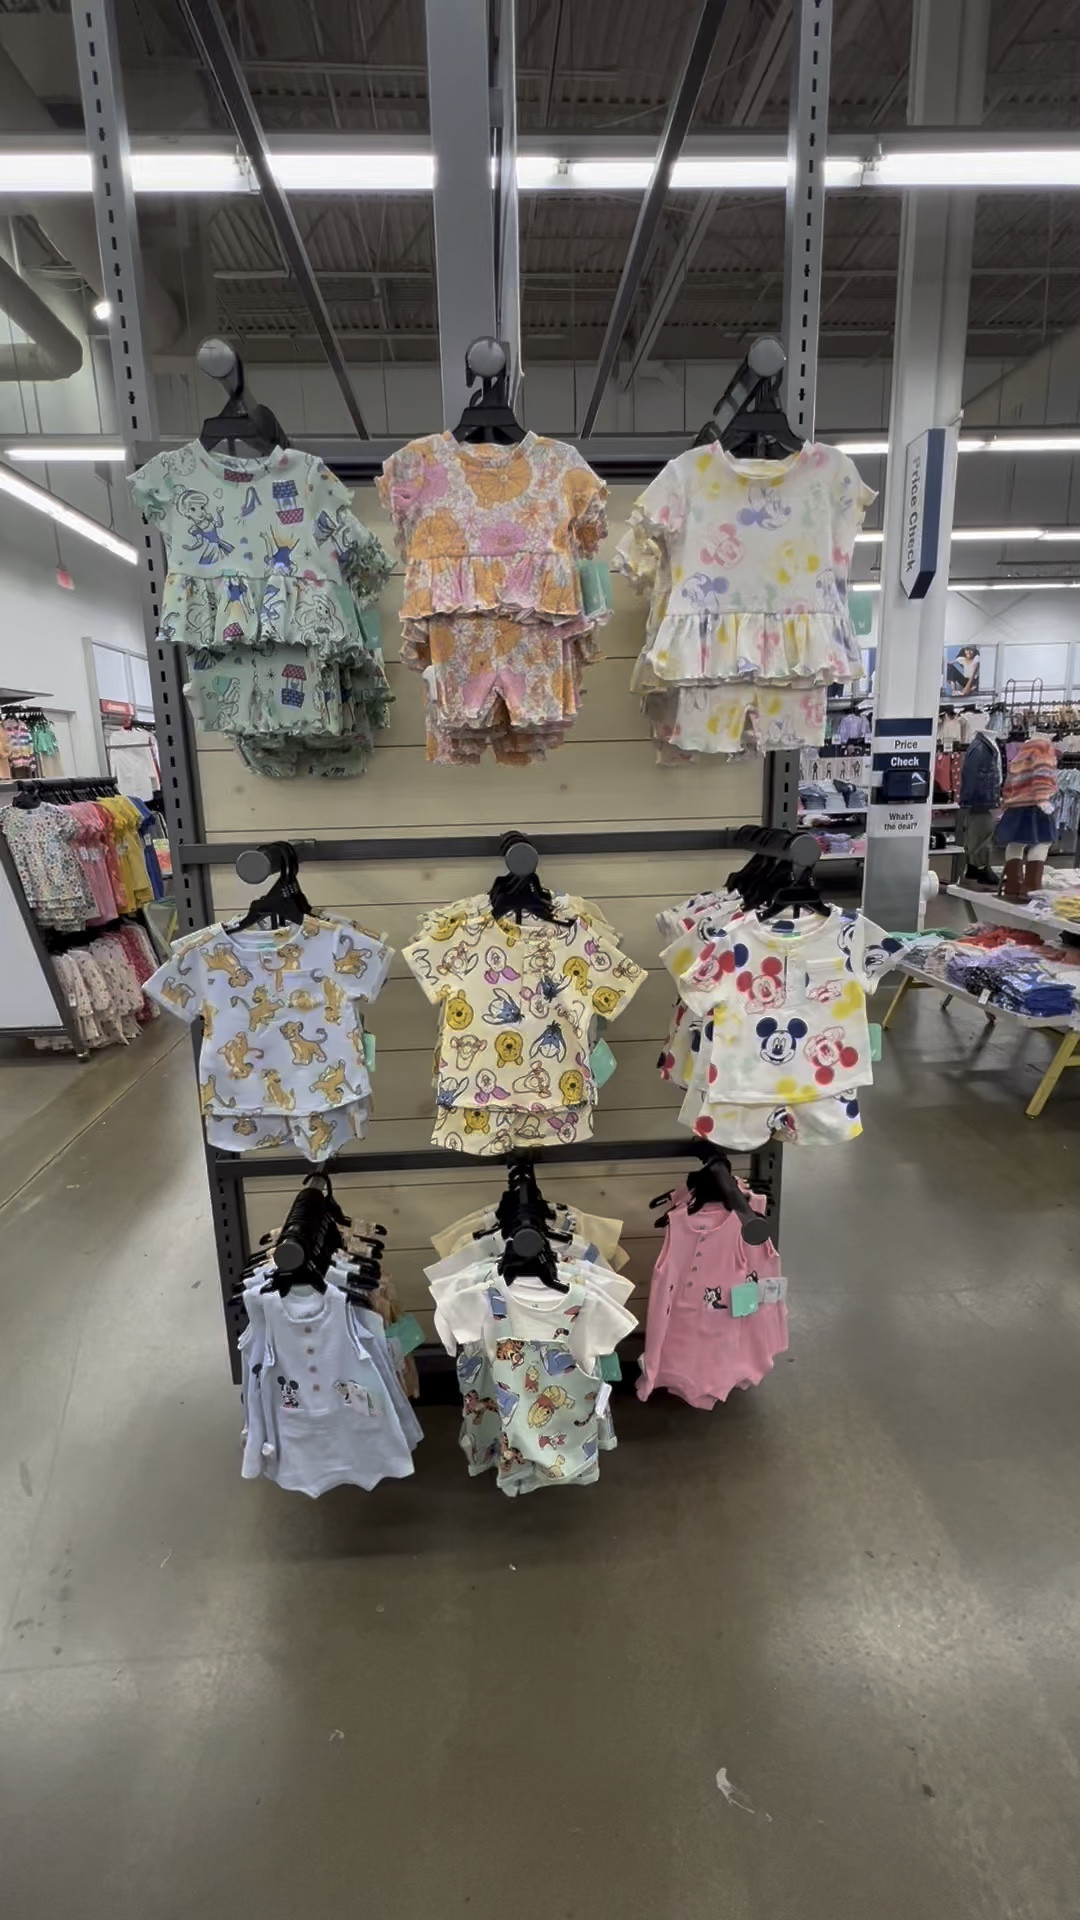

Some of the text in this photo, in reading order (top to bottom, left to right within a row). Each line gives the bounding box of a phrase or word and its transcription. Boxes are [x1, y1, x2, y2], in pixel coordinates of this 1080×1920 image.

[906, 456, 921, 573] Price Check
[894, 740, 918, 749] Price
[890, 756, 919, 767] Check
[889, 812, 914, 821] What's
[897, 822, 918, 830] deal?
